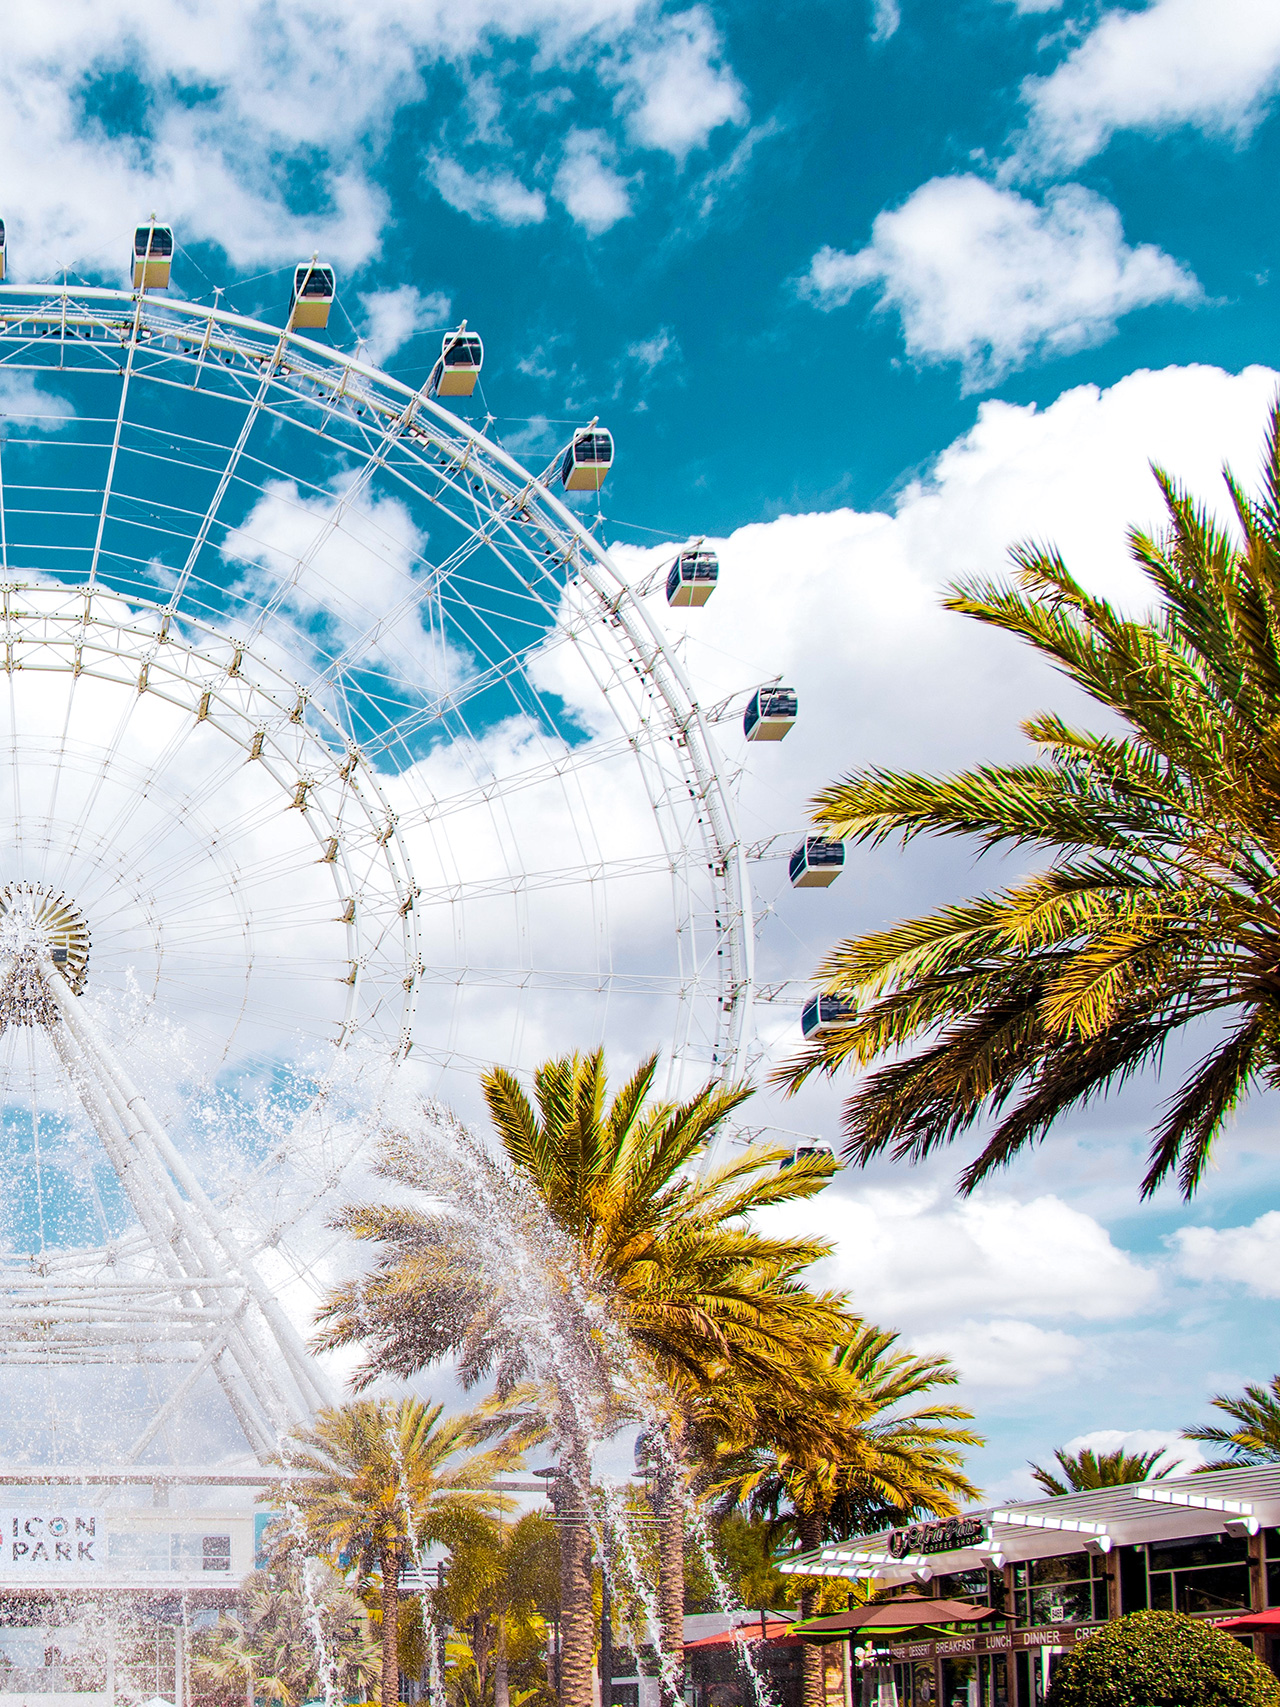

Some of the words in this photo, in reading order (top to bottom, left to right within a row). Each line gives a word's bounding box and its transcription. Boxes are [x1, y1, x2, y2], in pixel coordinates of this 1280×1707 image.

[12, 1517, 95, 1537] ICON
[12, 1541, 95, 1561] PARK
[924, 1541, 952, 1553] COFFEE
[956, 1536, 976, 1547] SHOP
[909, 1643, 931, 1657] DESSERT
[935, 1638, 976, 1654] BREAKFAST
[986, 1635, 1012, 1649] LUNCH
[1023, 1630, 1060, 1645] DINNER
